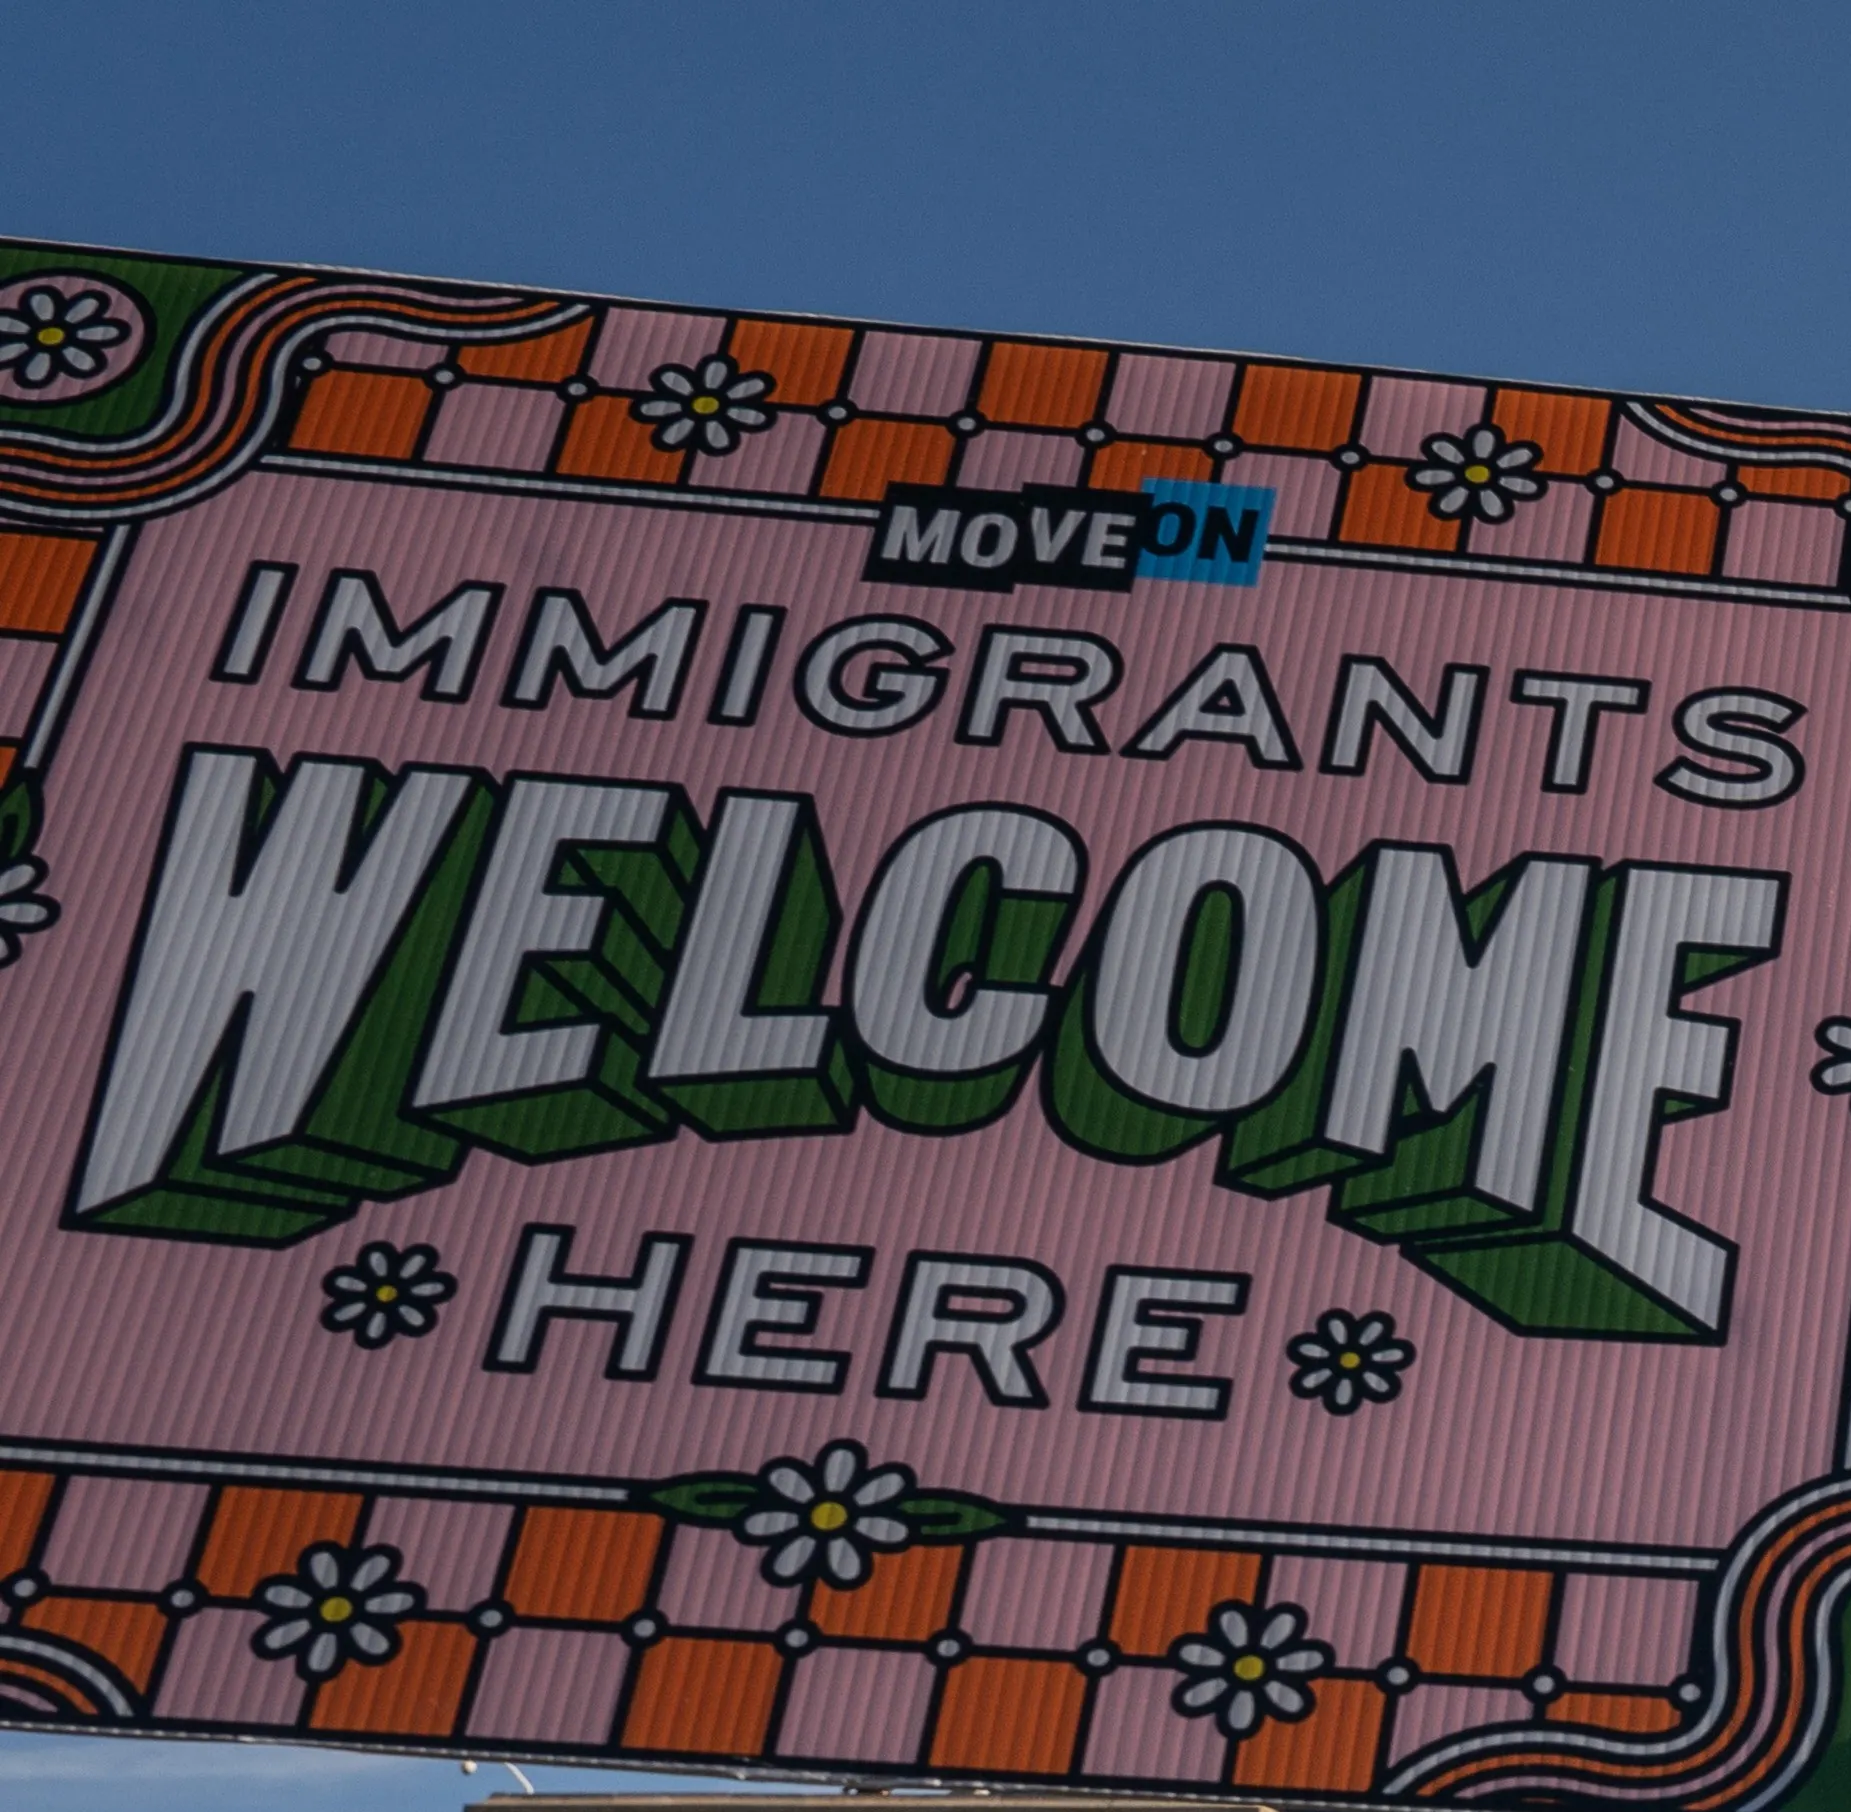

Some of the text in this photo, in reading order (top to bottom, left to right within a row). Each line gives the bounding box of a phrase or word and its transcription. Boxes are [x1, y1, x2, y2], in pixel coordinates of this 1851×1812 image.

[211, 559, 1809, 812] IMMIGRANTS
[59, 740, 1792, 1347] WELCOME
[483, 1222, 1253, 1421] HERE
